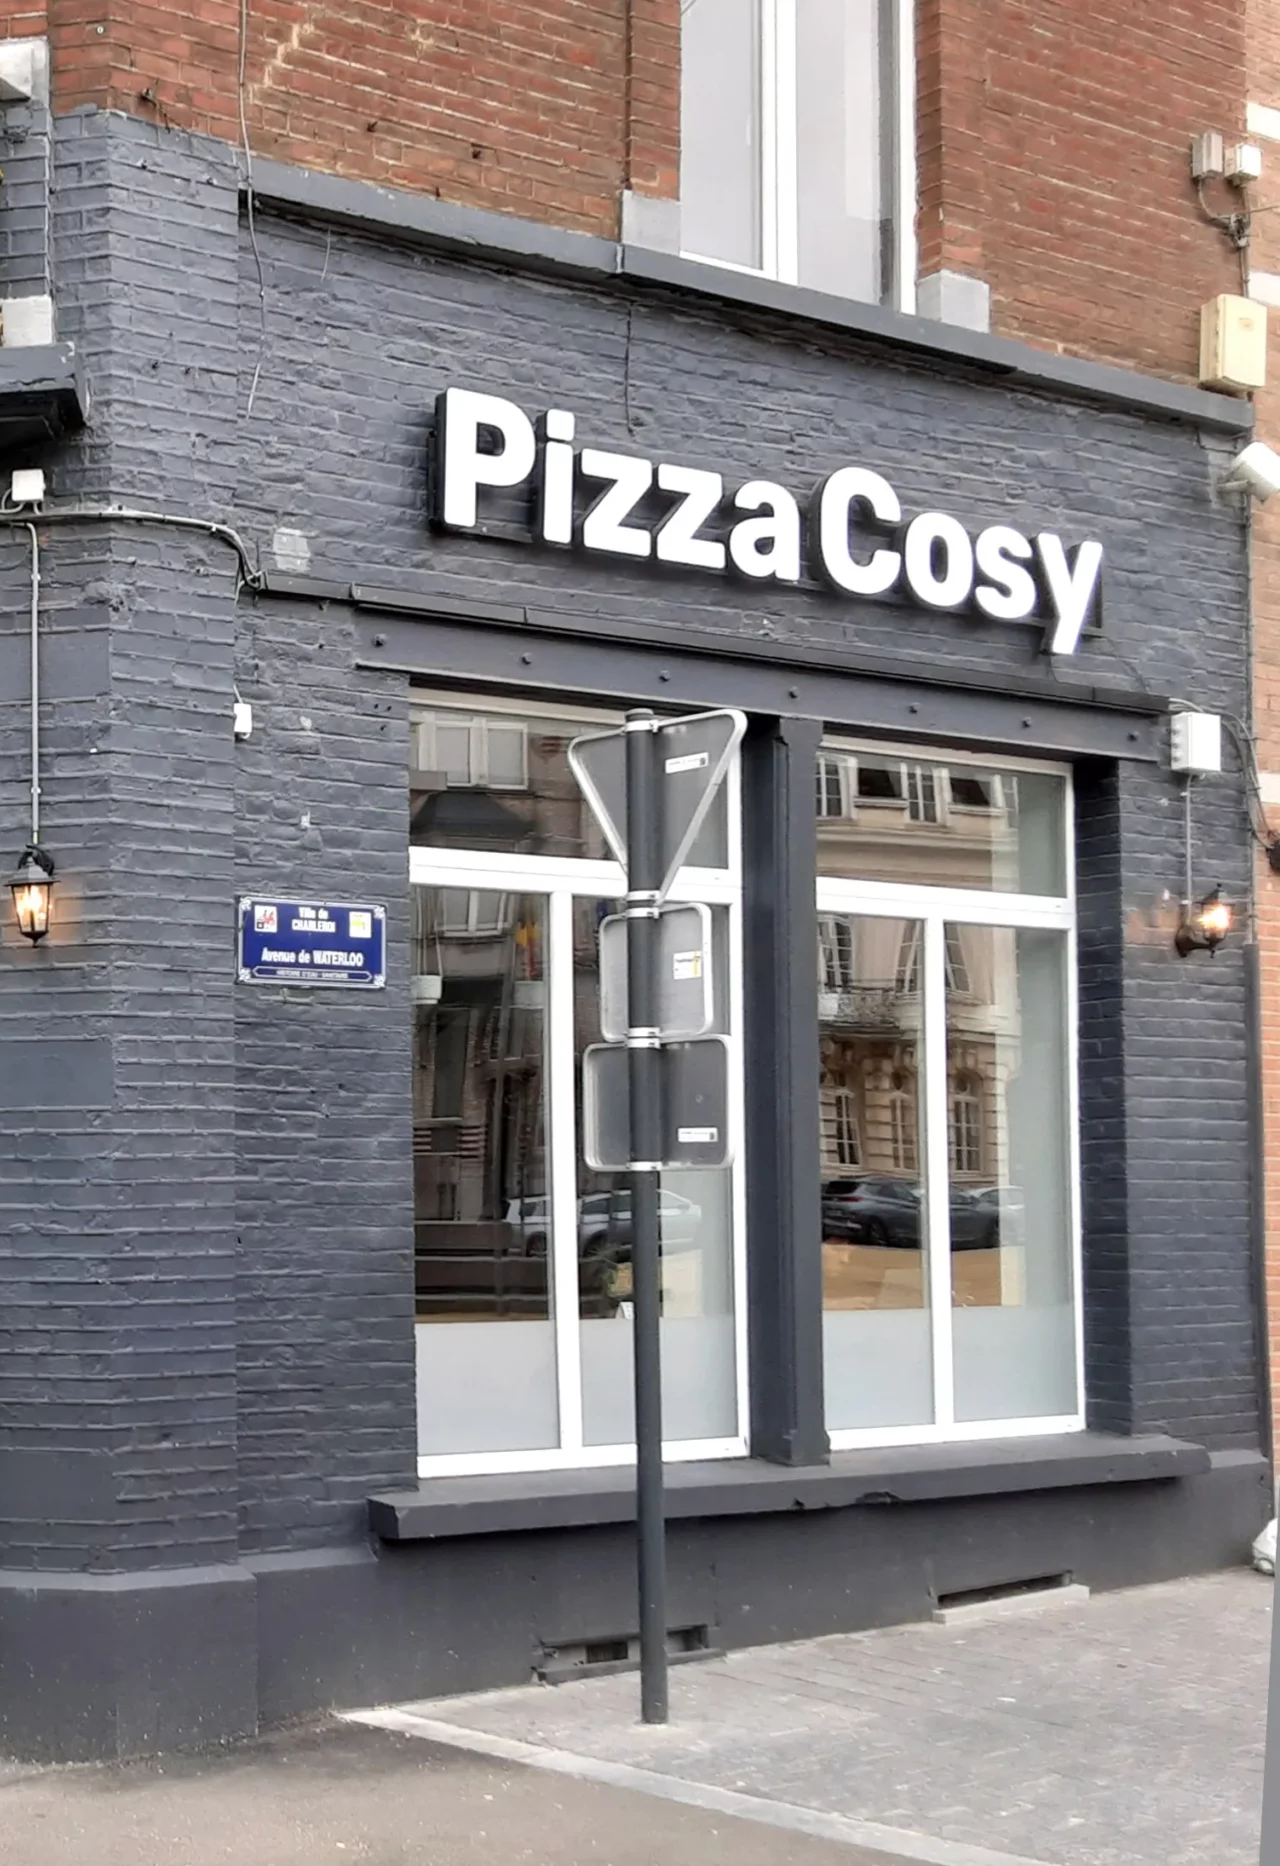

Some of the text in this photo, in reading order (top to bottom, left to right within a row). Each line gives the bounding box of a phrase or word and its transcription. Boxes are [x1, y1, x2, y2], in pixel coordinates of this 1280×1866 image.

[443, 386, 1104, 655] Pizza Cosy
[291, 919, 336, 933] CHARLEROI
[261, 947, 364, 967] Avenue de WATERLOO
